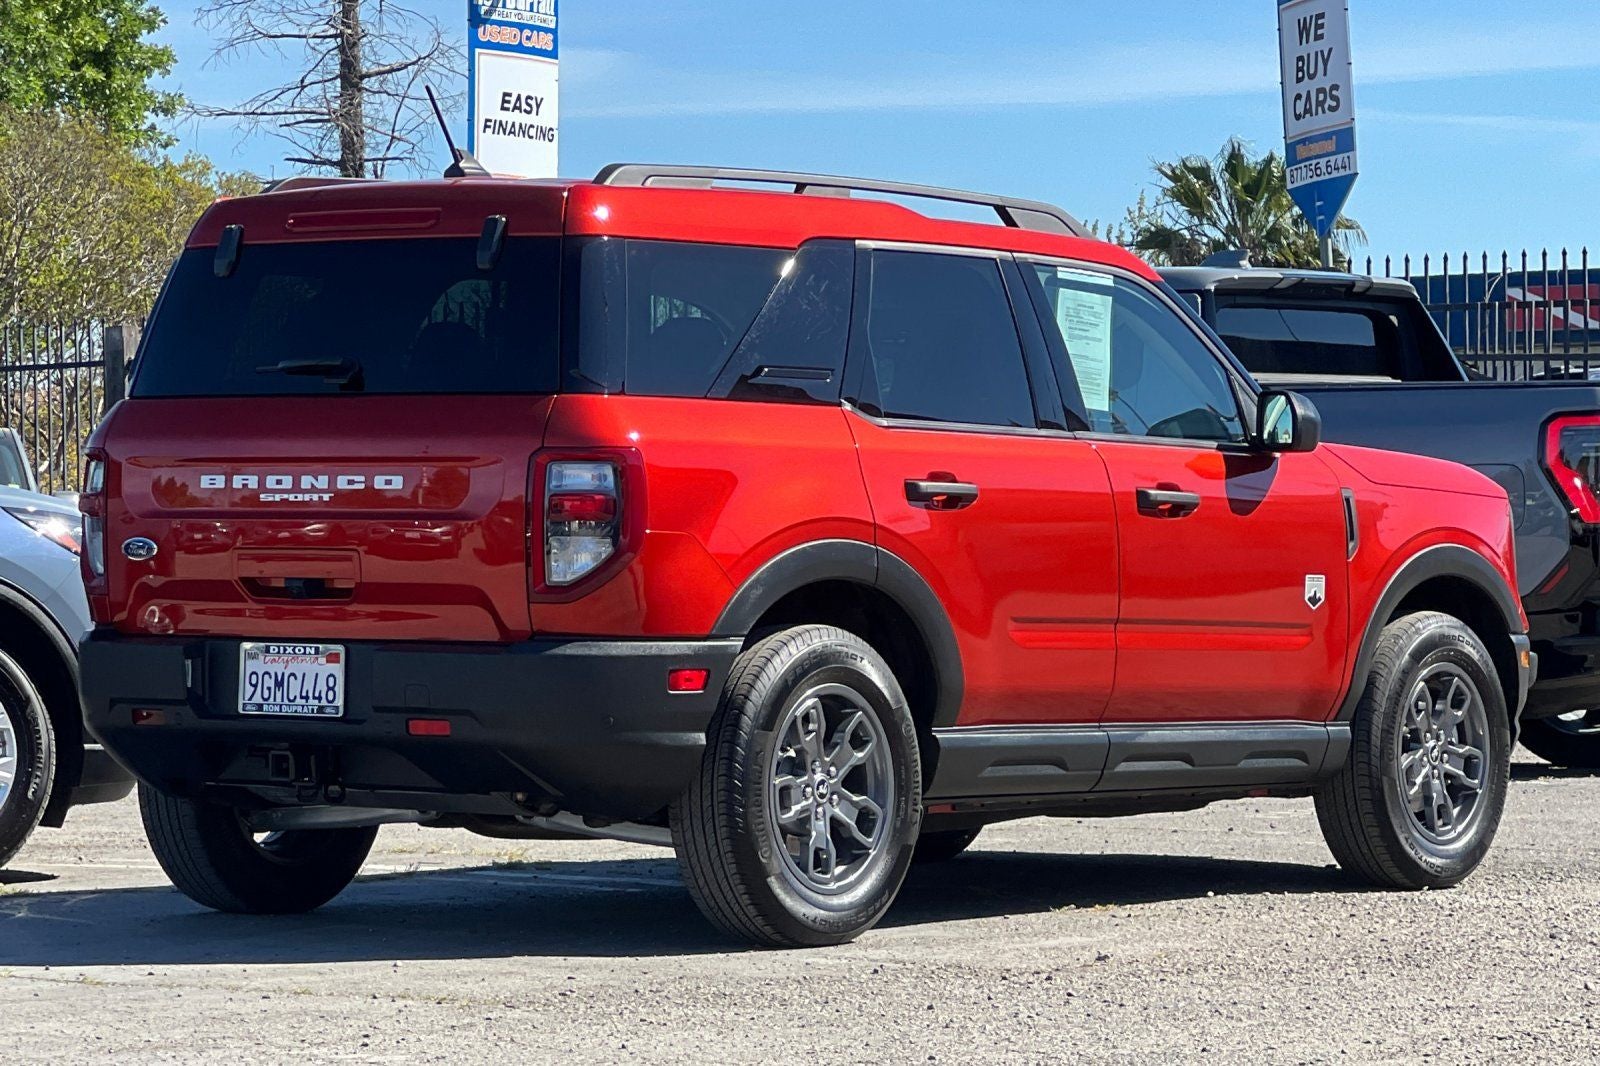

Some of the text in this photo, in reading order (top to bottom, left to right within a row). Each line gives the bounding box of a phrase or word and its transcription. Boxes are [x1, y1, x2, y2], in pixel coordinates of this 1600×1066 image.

[494, 9, 512, 19] TREAT
[514, 12, 525, 21] YOU
[526, 13, 537, 23] LIKE
[478, 24, 554, 50] USED CARS
[1297, 12, 1325, 46] WE
[1296, 47, 1333, 84] BUY
[500, 91, 544, 116] EASY
[1293, 83, 1340, 121] CARS
[483, 118, 555, 143] FINANCING
[1289, 156, 1351, 185] 877.756.6441
[200, 475, 404, 489] BRONCO
[259, 493, 334, 502] SPORT
[269, 645, 316, 654] DIXON
[262, 655, 320, 670] California
[248, 671, 337, 704] 9GMC448
[263, 704, 280, 712] RON
[281, 704, 319, 714] DUPRATT
